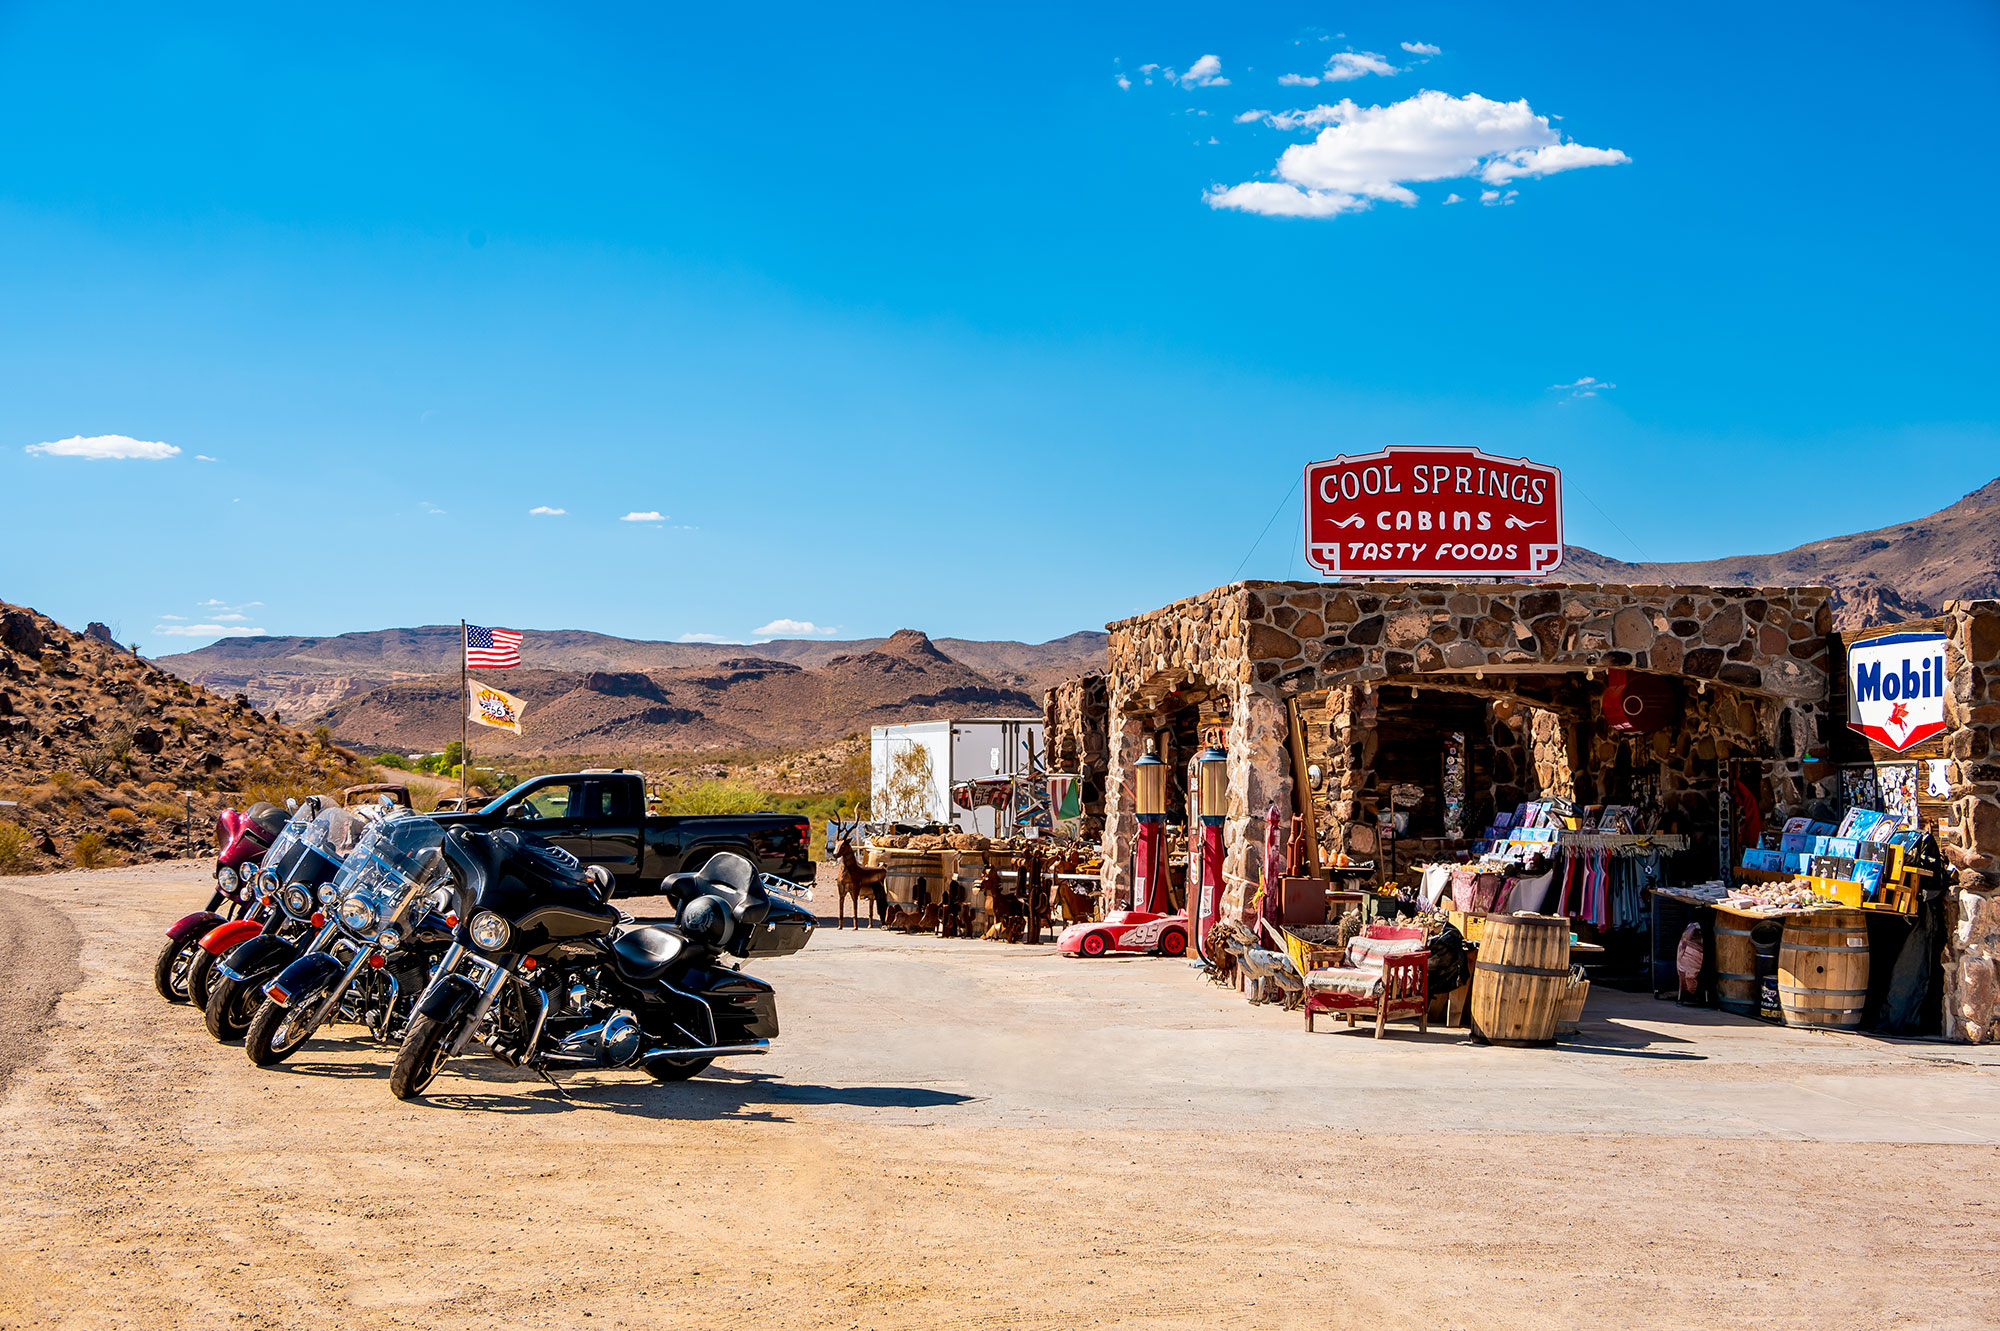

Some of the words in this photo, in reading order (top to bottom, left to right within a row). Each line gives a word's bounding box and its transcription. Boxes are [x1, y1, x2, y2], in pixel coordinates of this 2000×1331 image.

[1319, 465, 1402, 504] COOL
[1413, 464, 1547, 505] SPRINGS
[1376, 511, 1492, 531] CABINS
[1348, 543, 1427, 561] TASTY
[1435, 543, 1518, 561] FOODS
[1857, 656, 1943, 702] Mobil
[491, 705, 503, 716] 66
[1135, 925, 1159, 945] 95
